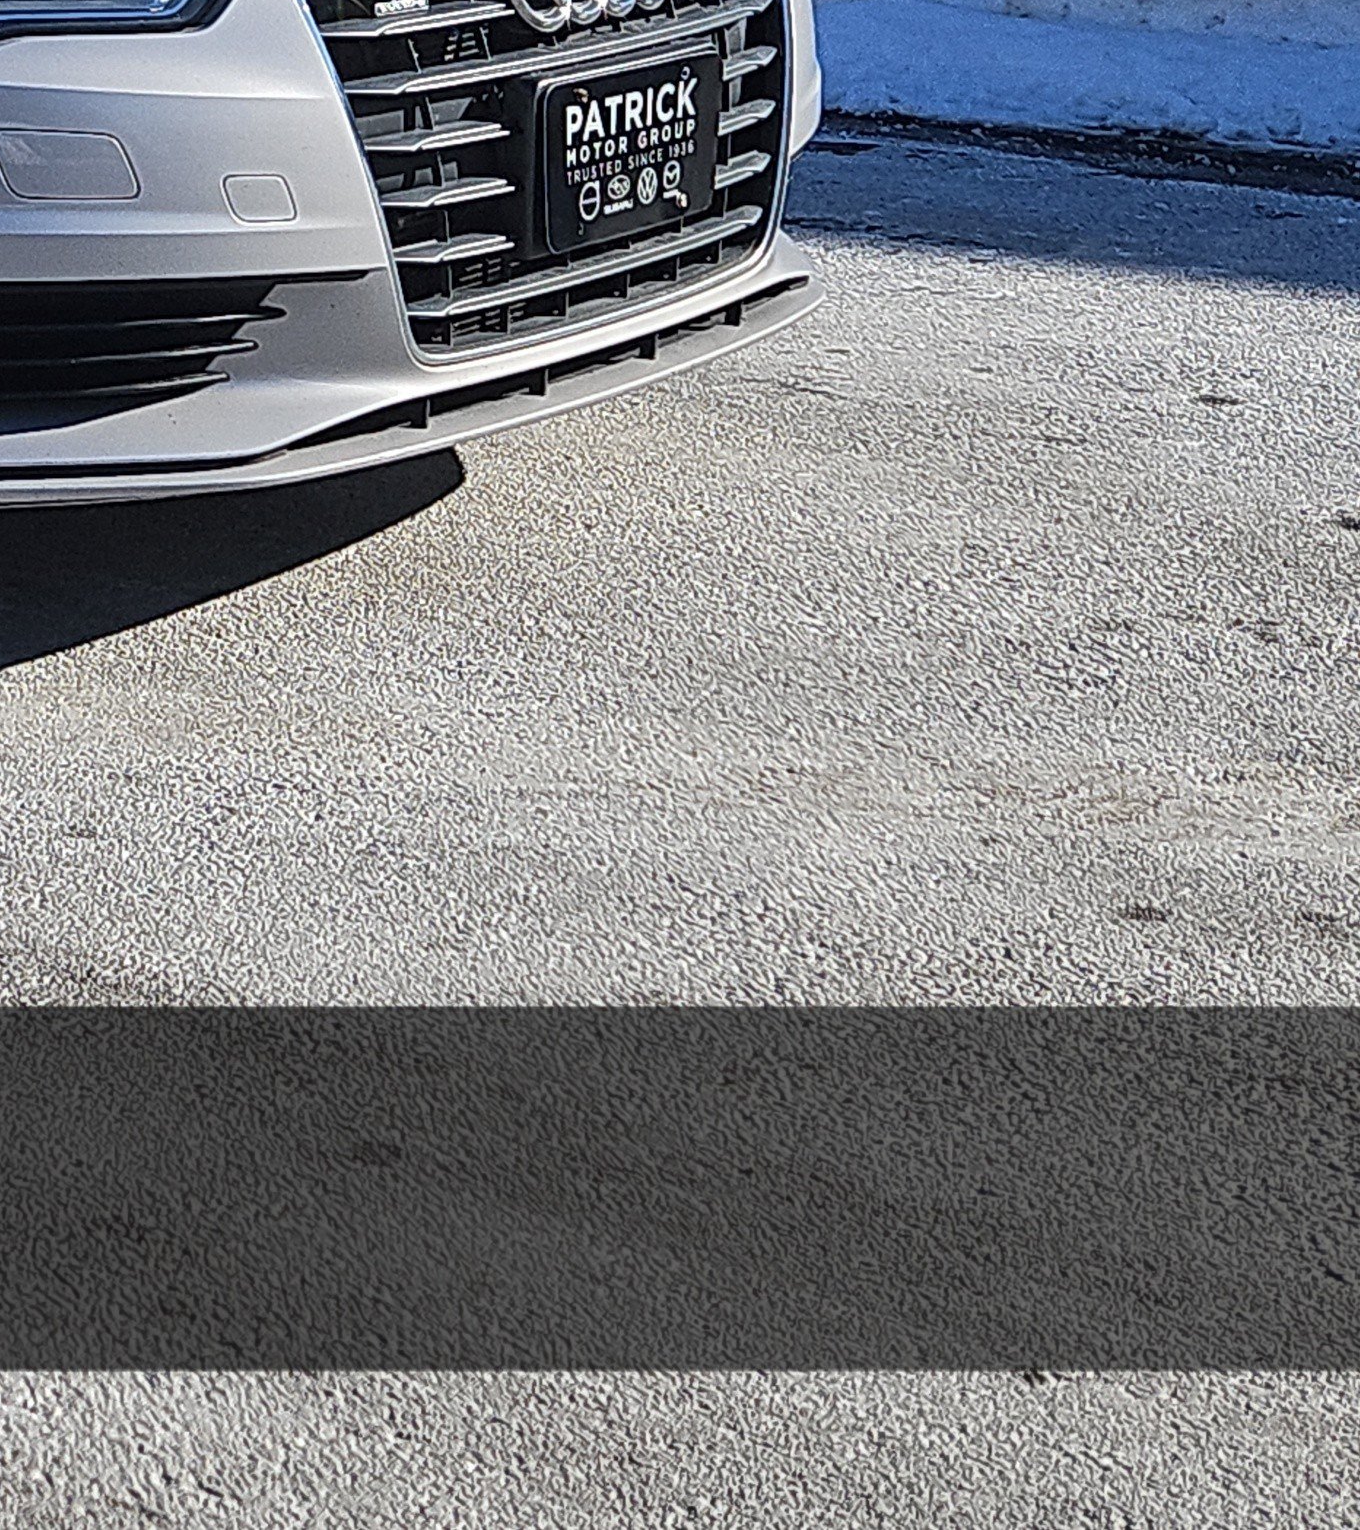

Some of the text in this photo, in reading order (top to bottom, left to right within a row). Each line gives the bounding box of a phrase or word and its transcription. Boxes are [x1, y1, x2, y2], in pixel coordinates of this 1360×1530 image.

[566, 78, 697, 146] PATRICK
[566, 119, 696, 168] MOTOR GROUP
[566, 160, 622, 185] TRUSTED
[628, 148, 663, 170] SINCE
